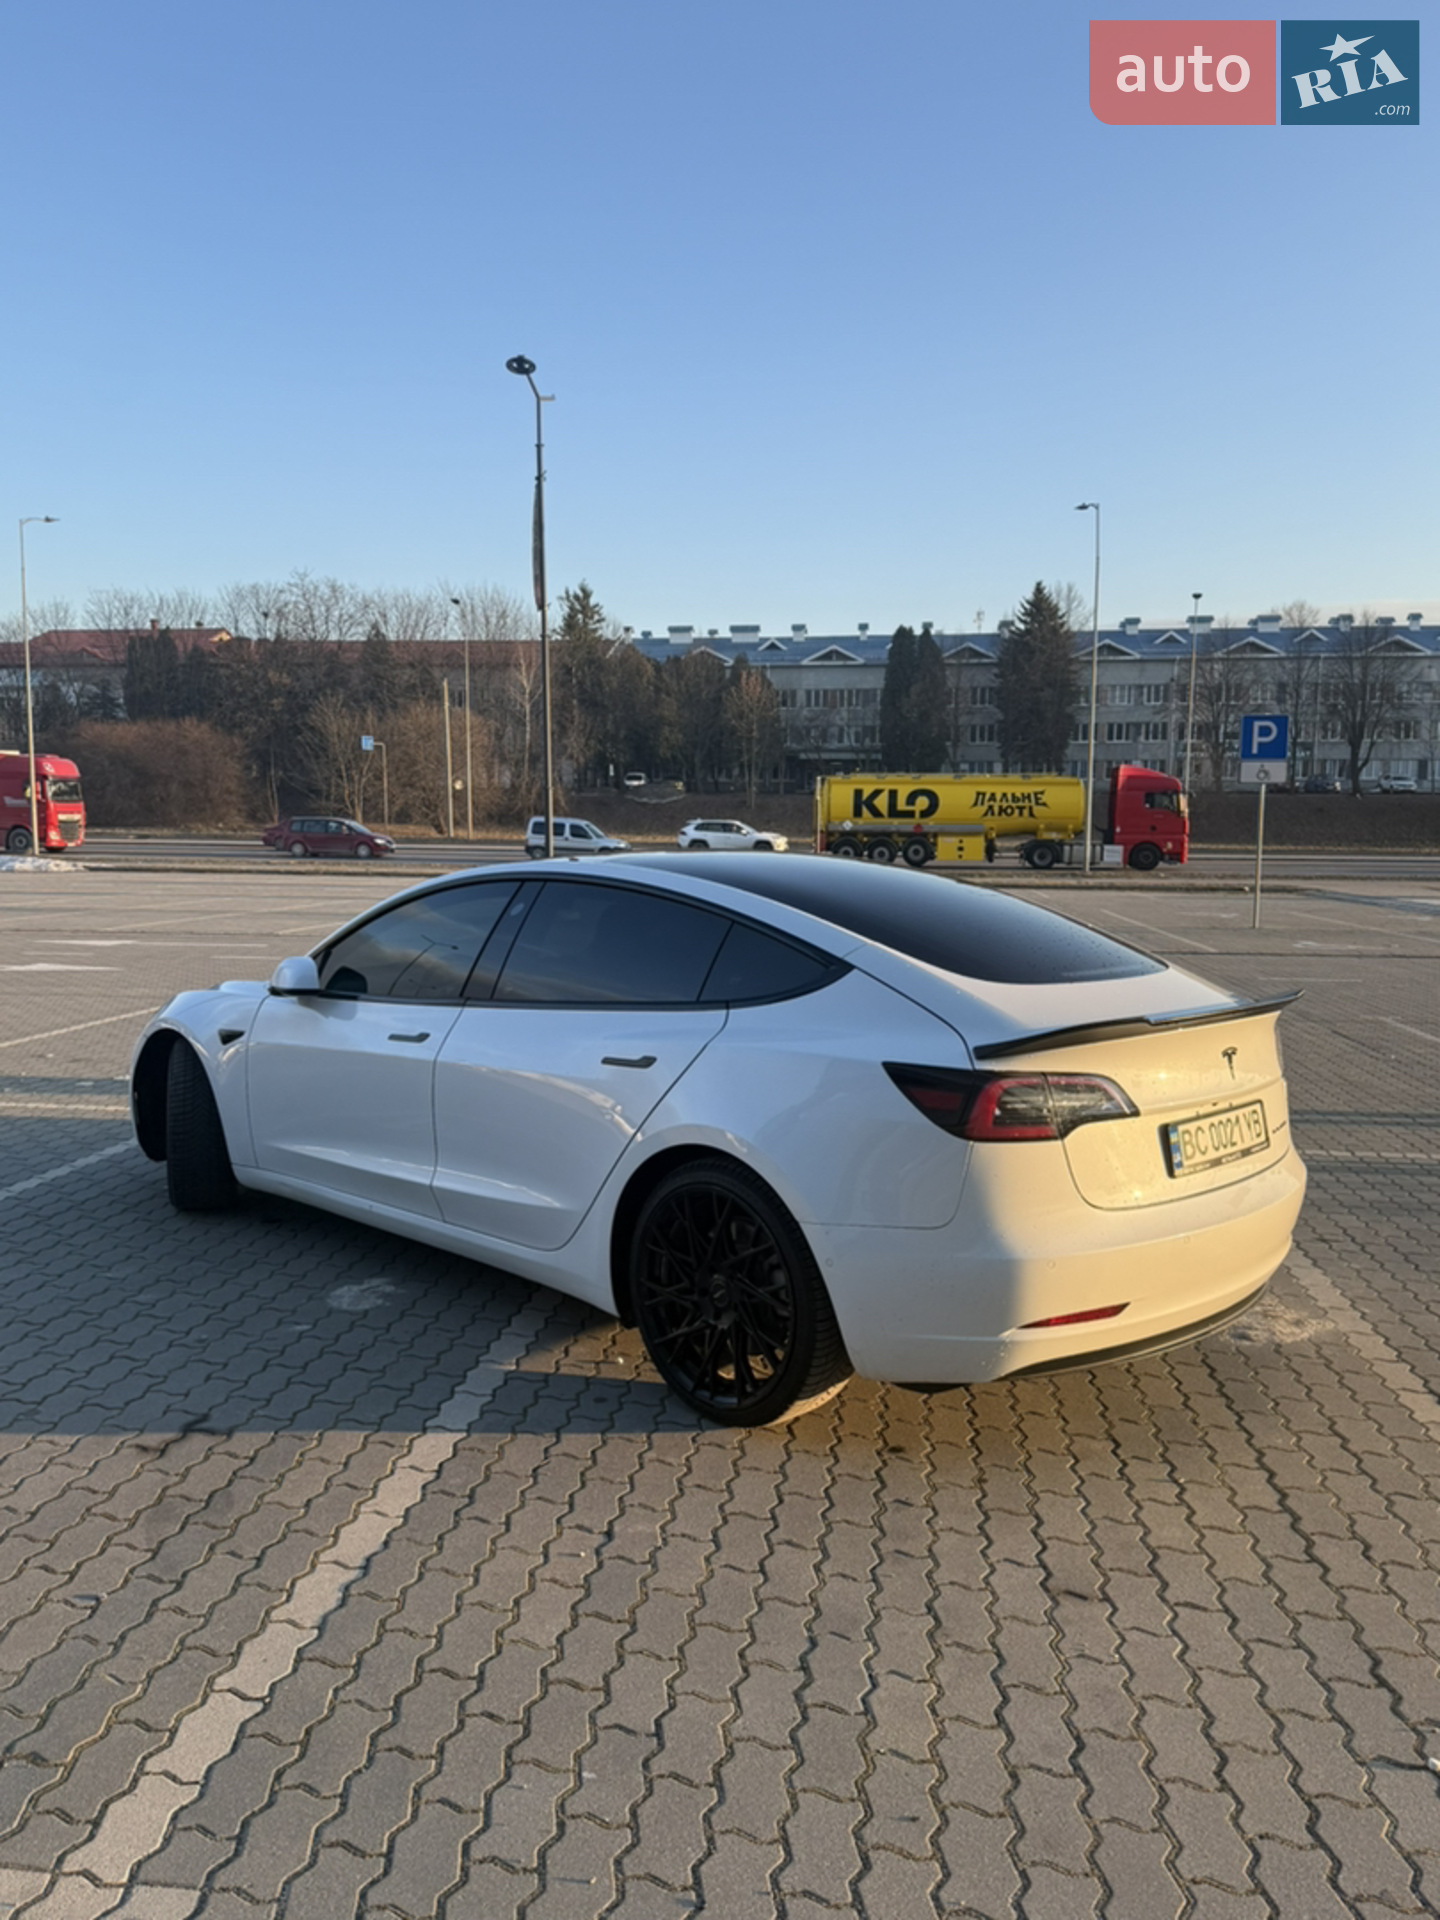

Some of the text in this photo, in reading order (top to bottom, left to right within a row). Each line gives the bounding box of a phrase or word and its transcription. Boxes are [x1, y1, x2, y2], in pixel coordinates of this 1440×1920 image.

[1251, 720, 1278, 755] P
[853, 788, 940, 819] KLO
[971, 789, 1051, 809] ПАЛЬНЕ
[1180, 1125, 1208, 1161] BC
[1208, 1114, 1245, 1152] 0021
